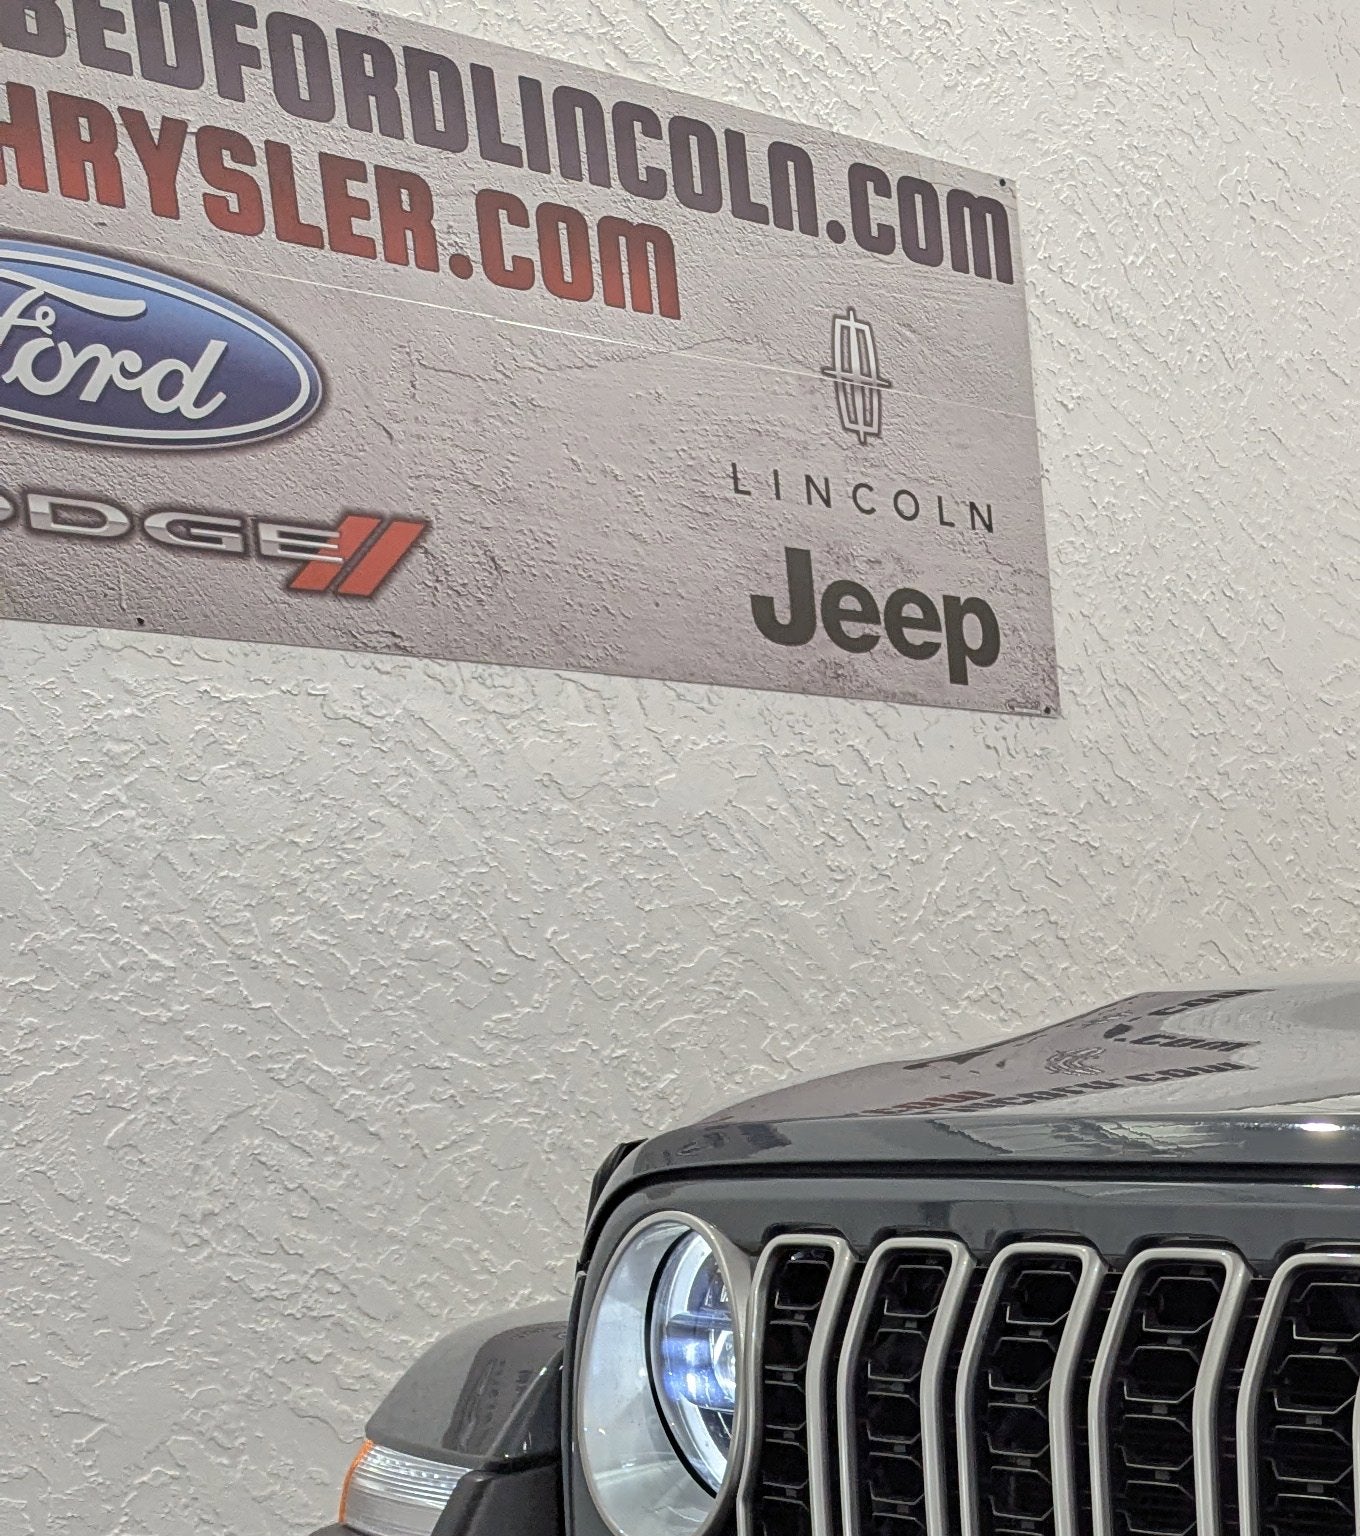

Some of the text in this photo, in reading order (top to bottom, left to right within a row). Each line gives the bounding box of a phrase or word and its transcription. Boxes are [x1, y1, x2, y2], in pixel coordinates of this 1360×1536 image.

[0, 268, 229, 421] Ford
[0, 492, 345, 565] DGE
[730, 461, 996, 535] LINCOLN
[751, 546, 1001, 686] Jeep
